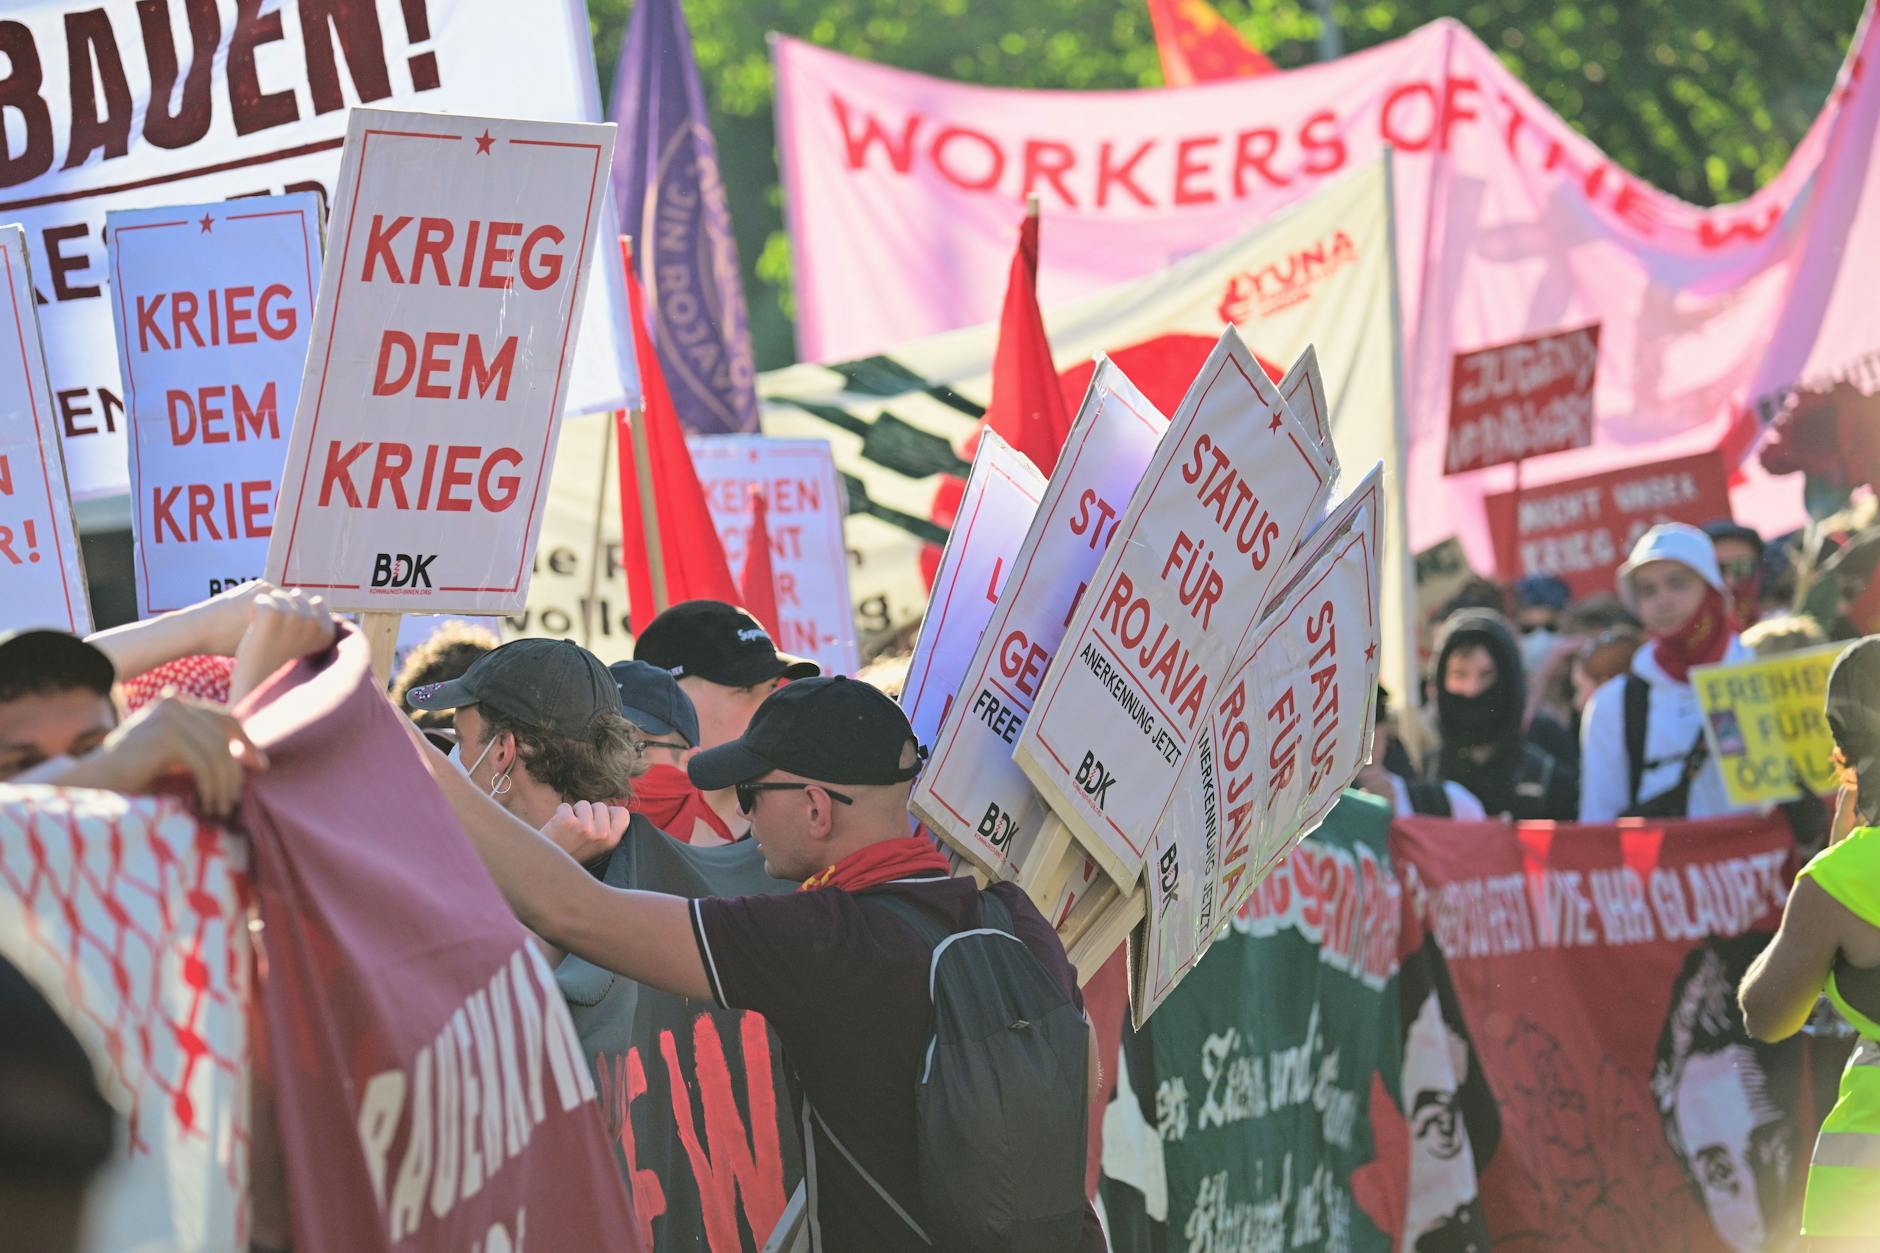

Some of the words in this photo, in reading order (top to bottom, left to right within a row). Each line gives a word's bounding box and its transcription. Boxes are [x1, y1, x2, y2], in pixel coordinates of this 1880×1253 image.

[828, 90, 1349, 210] WORKERS
[1381, 78, 1478, 154] OF
[360, 214, 566, 291] KRIEG
[136, 283, 298, 352] KRIEG
[372, 330, 518, 401] DEM
[165, 382, 280, 446] DEM
[152, 480, 278, 544] KRIE
[318, 440, 524, 513] KRIEG
[1182, 433, 1280, 572] STATUS
[371, 553, 438, 588] BDK
[1160, 531, 1225, 631] FÜR
[1100, 571, 1208, 730] ROJAVA
[973, 688, 1024, 745] FREE
[1081, 642, 1153, 736] ANERKENNUNG
[1151, 726, 1182, 768] JETZT
[1075, 750, 1117, 811] BDK
[977, 802, 1020, 858] BDK
